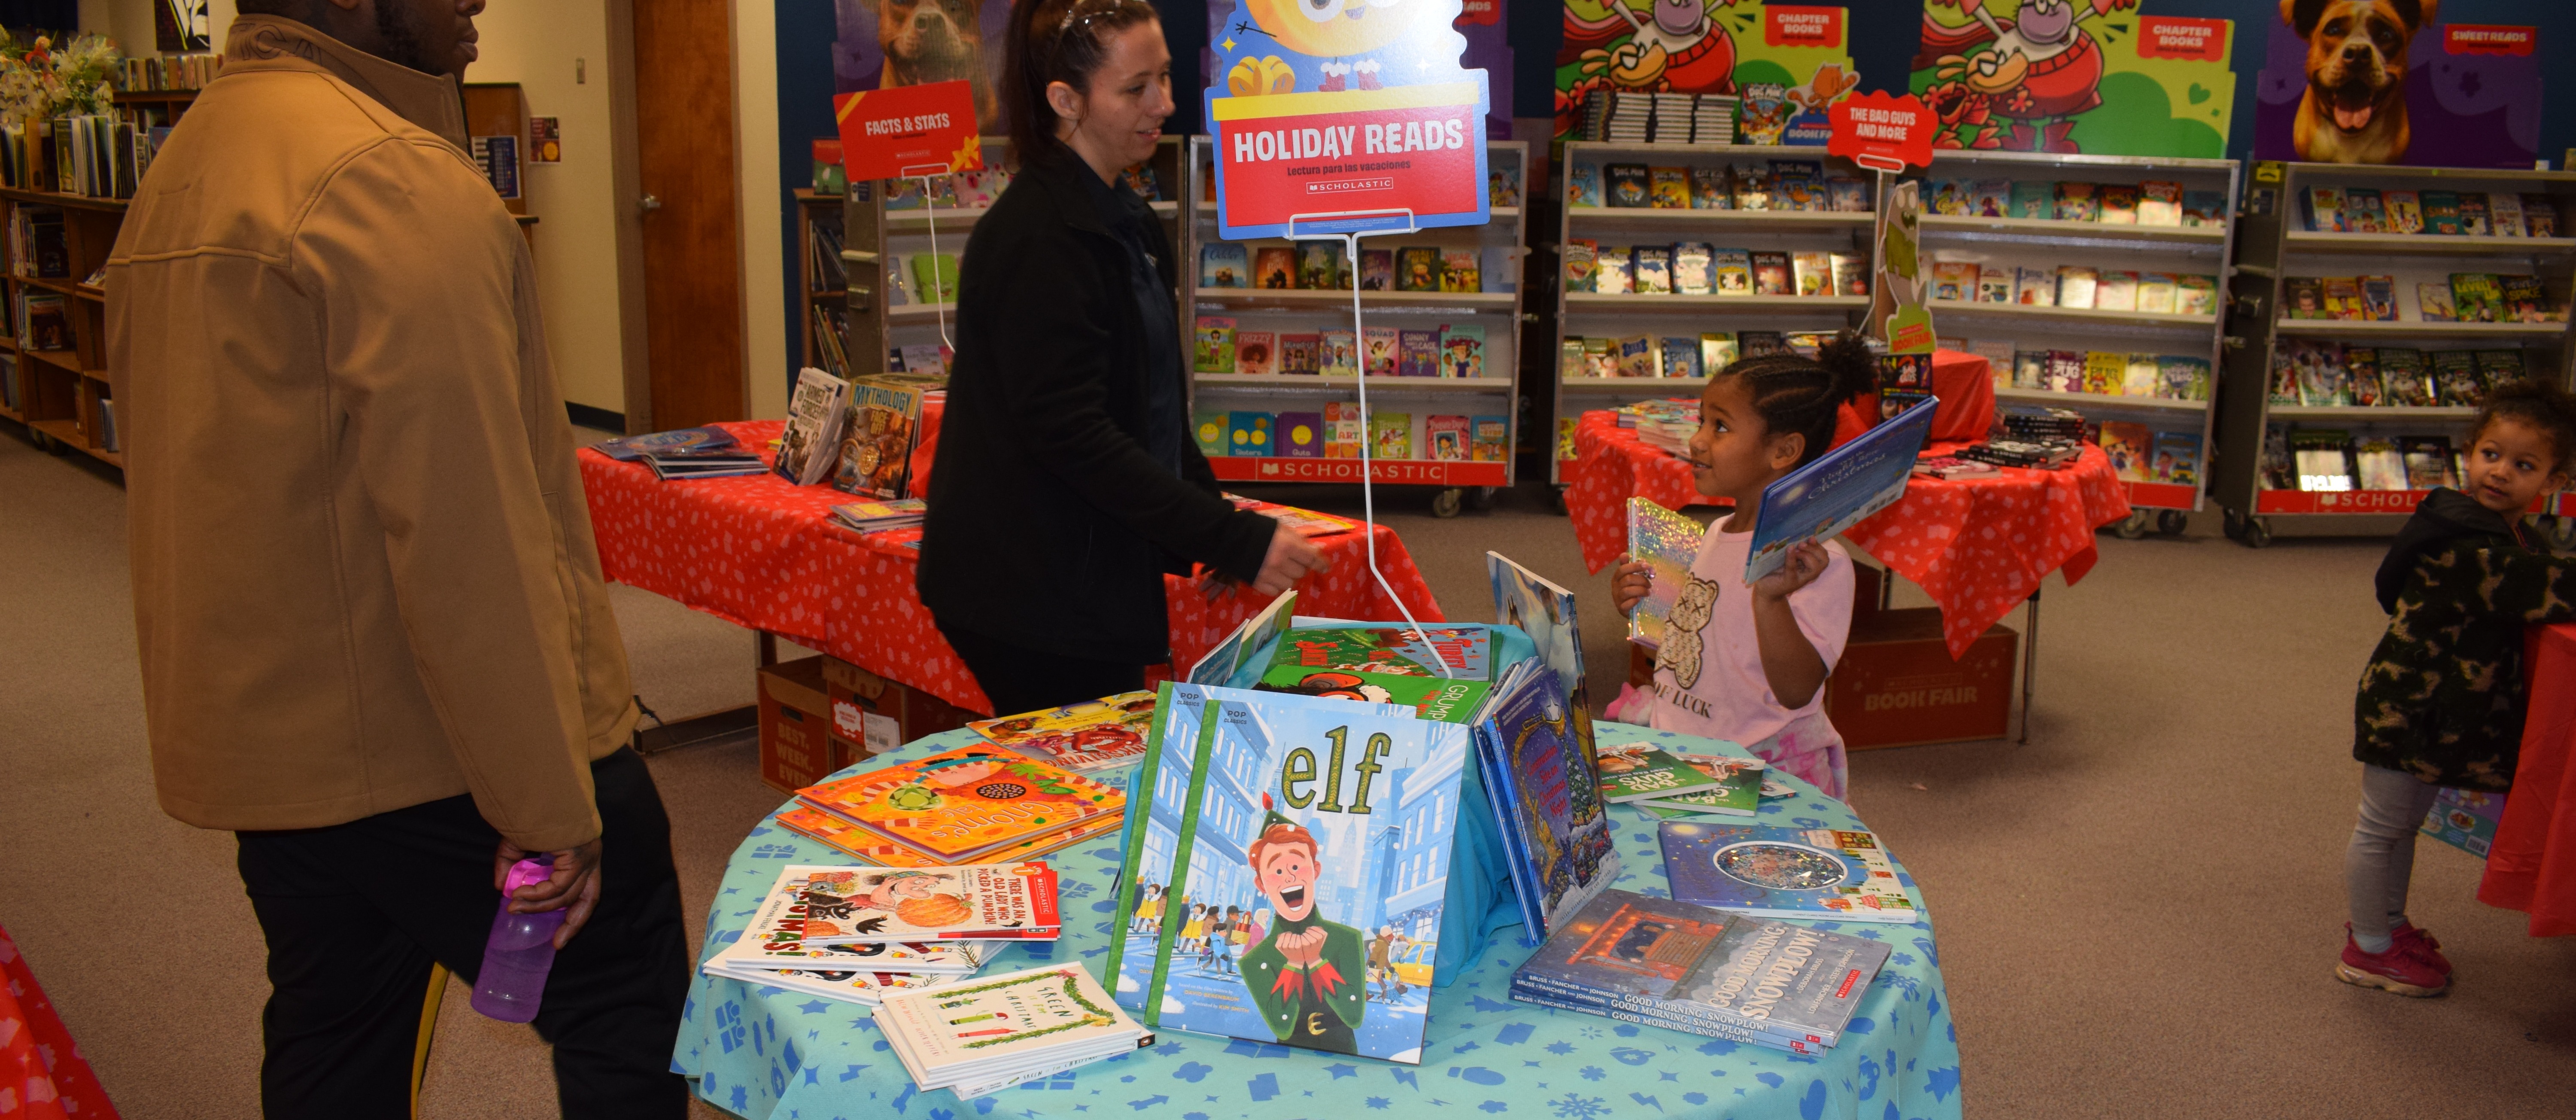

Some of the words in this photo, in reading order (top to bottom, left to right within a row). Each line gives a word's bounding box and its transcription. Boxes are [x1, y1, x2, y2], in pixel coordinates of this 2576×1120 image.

[1777, 13, 1830, 24] CHAPTER
[1783, 24, 1823, 35] BOOKS
[2153, 24, 2212, 37] CHAPTER
[2452, 30, 2489, 42] SWEET
[2490, 32, 2527, 42] READS
[2159, 36, 2204, 47] BOOKS
[865, 118, 902, 136] FACTS
[904, 116, 913, 132] &
[914, 113, 950, 131] STATS
[1850, 107, 1868, 121] THE
[1869, 108, 1889, 124] BAD
[1889, 110, 1917, 126] GUYS
[1234, 125, 1356, 163] HOLIDAY
[1365, 119, 1464, 155] READS
[1788, 129, 1819, 139] BOOK
[1856, 124, 1877, 138] AND
[1878, 127, 1908, 141] MORE
[1288, 167, 1321, 176] Lectura
[1323, 165, 1343, 175] para
[1345, 164, 1358, 172] las
[1360, 161, 1411, 170] vacaciones
[1319, 180, 1391, 191] SCHOLASTIC
[1238, 334, 1271, 344] FRIZZY
[1365, 329, 1395, 338] SQUAD
[2052, 364, 2080, 379] PUG
[805, 383, 826, 404] ARMED
[854, 383, 912, 415] MYTHOLOGY
[800, 398, 821, 420] FORCES
[1338, 431, 1360, 439] ART
[1291, 448, 1311, 457] Guts
[1284, 463, 1442, 480] SCHOLASTIC
[1807, 453, 1886, 499] Christmas
[1295, 641, 1338, 666] SANTA
[1430, 638, 1472, 669] TURKEY
[1428, 685, 1469, 721] GRUMP
[1672, 690, 1713, 718] LUCK
[1865, 690, 1926, 710] BOOK
[1929, 686, 1977, 706] FAIR
[1281, 724, 1392, 815] elf
[1526, 745, 1558, 777] Construction
[1539, 769, 1550, 785] Site
[1618, 771, 1674, 786] GUYS
[1630, 779, 1680, 791] BAD
[1538, 779, 1567, 807] Christmas
[939, 804, 986, 818] tale
[1549, 796, 1567, 817] Night
[931, 802, 1054, 838] Gnome's
[977, 868, 991, 887] PICKED
[993, 877, 1005, 890] OLD
[1009, 878, 1022, 895] THERE
[994, 892, 1009, 905] LADY
[1011, 896, 1024, 908] WAS
[1037, 881, 1050, 913] SCHOLASTIC
[767, 900, 782, 917] JONATHAN
[981, 895, 997, 925] PUMPKIN!
[997, 906, 1010, 920] WHO
[1013, 910, 1026, 919] AN
[758, 917, 770, 930] FENSKE
[1708, 976, 1748, 1008] GOOD
[1738, 926, 1790, 977] MORNING,
[1739, 928, 1826, 1021] SNOWPLOW!
[1798, 969, 1816, 991] DEBORAH
[1810, 958, 1825, 972] BRUSS
[1807, 1002, 1819, 1014] LOU
[1815, 983, 1833, 1005] FANCHER
[1829, 966, 1844, 981] STEVE
[1840, 948, 1855, 968] JOHNSON
[1841, 969, 1859, 994] SCHOLASTIC
[1005, 990, 1037, 1029] CHRISTMAS
[1037, 986, 1074, 1017] GREEN
[1516, 979, 1535, 988] BRUSS
[1539, 984, 1567, 995] FANCHER
[1576, 992, 1605, 1004] JOHNSON
[1610, 998, 1639, 1012] GOOD
[1692, 1018, 1754, 1038] SNOWPLOW!
[1529, 975, 1547, 983] BRUSS
[1552, 979, 1580, 991] FANCHER
[1589, 987, 1619, 999] JOHNSON
[1624, 994, 1653, 1007] GOOD
[1707, 1012, 1769, 1032] SNOWPLOW!
[1514, 995, 1533, 1003] BRUSS
[1537, 999, 1566, 1009] FANCHER
[1576, 1006, 1606, 1017] JOHNSON
[1612, 1011, 1640, 1023] GOOD
[1695, 1027, 1758, 1045] SNOWPLOW!
[1023, 1071, 1042, 1080] GREEN
